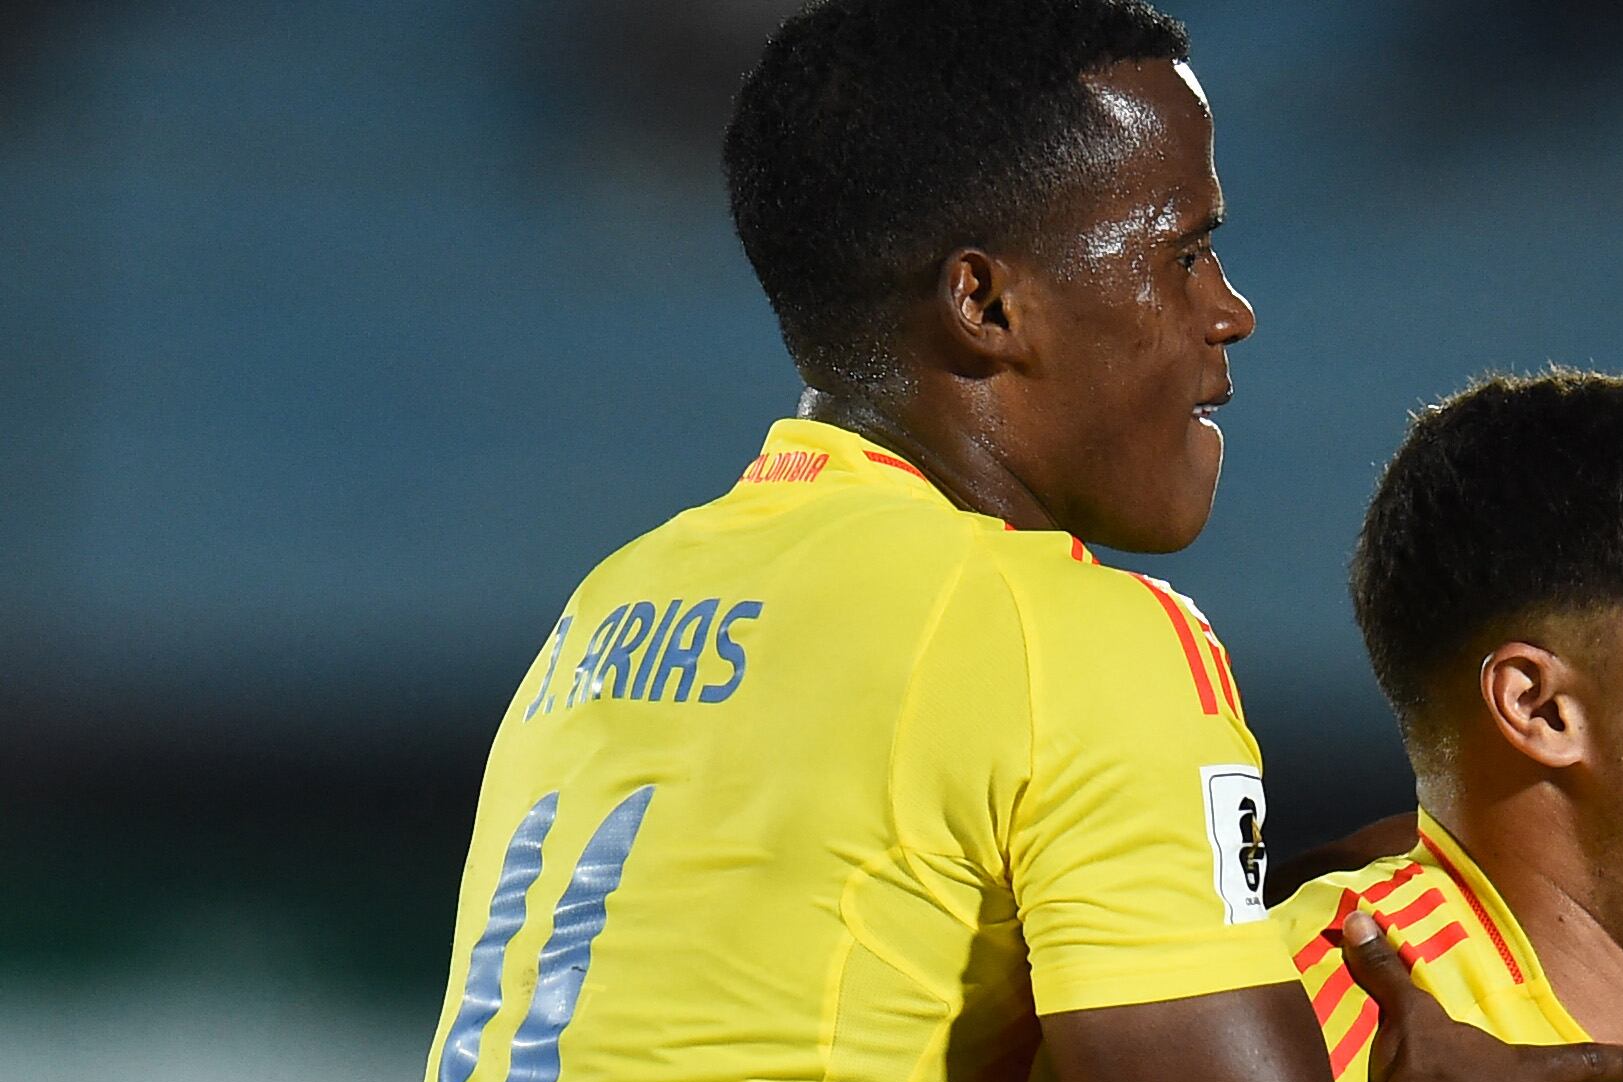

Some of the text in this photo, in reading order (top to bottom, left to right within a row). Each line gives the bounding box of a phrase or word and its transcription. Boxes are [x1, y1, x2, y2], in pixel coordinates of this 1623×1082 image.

[740, 450, 830, 483] OLOMBIA
[522, 597, 764, 723] J. ARIAS
